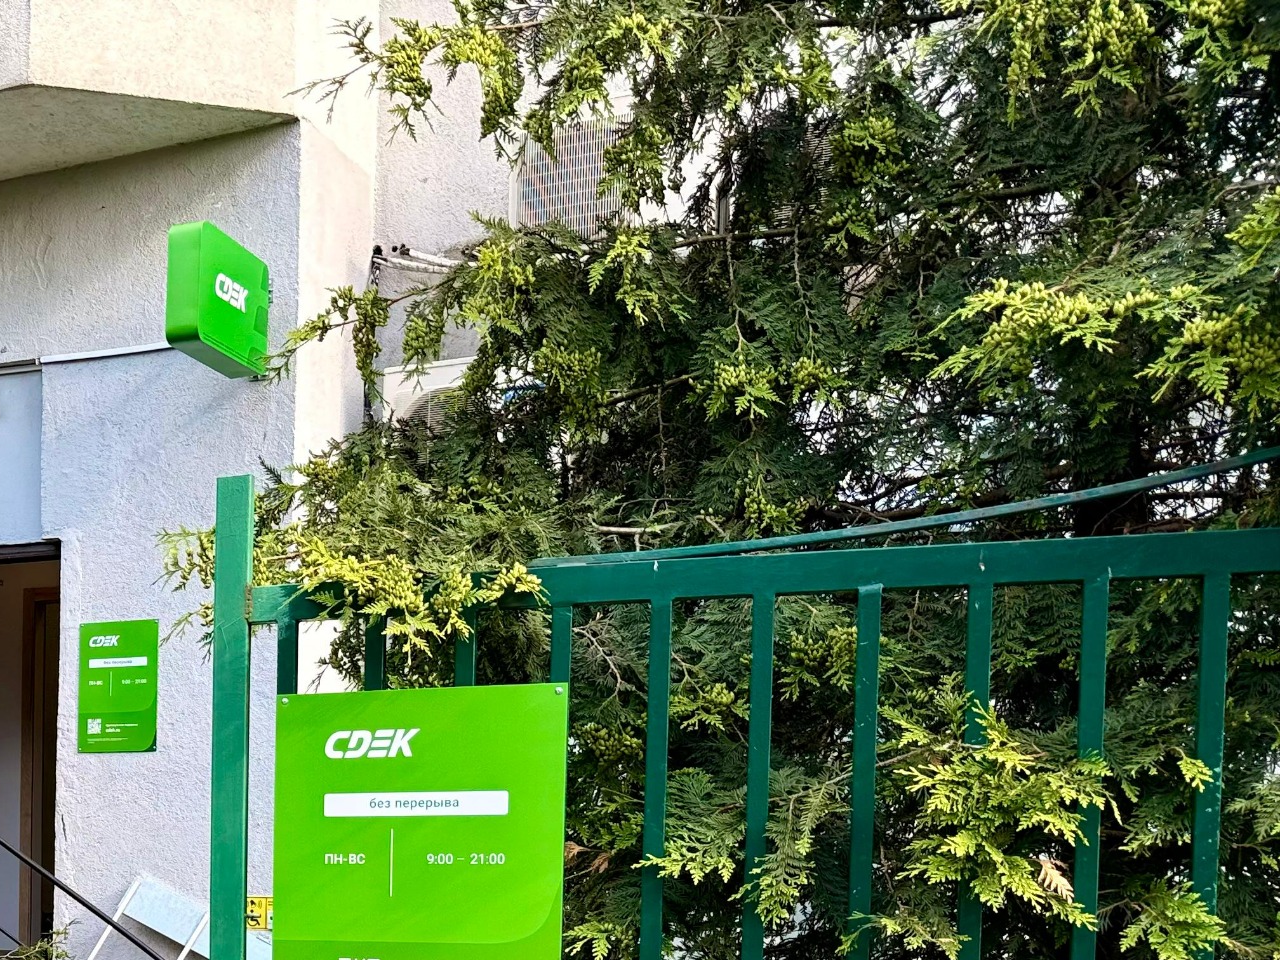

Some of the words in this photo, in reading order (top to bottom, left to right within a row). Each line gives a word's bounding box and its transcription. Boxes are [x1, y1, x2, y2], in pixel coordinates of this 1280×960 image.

[215, 272, 248, 314] CDEK
[89, 635, 120, 648] CDEK
[324, 728, 420, 759] CDEK
[369, 797, 391, 809] без
[394, 798, 460, 811] перерыва
[324, 853, 366, 865] ПН-ВС
[426, 853, 454, 865] 9:00
[470, 853, 506, 865] 21:00
